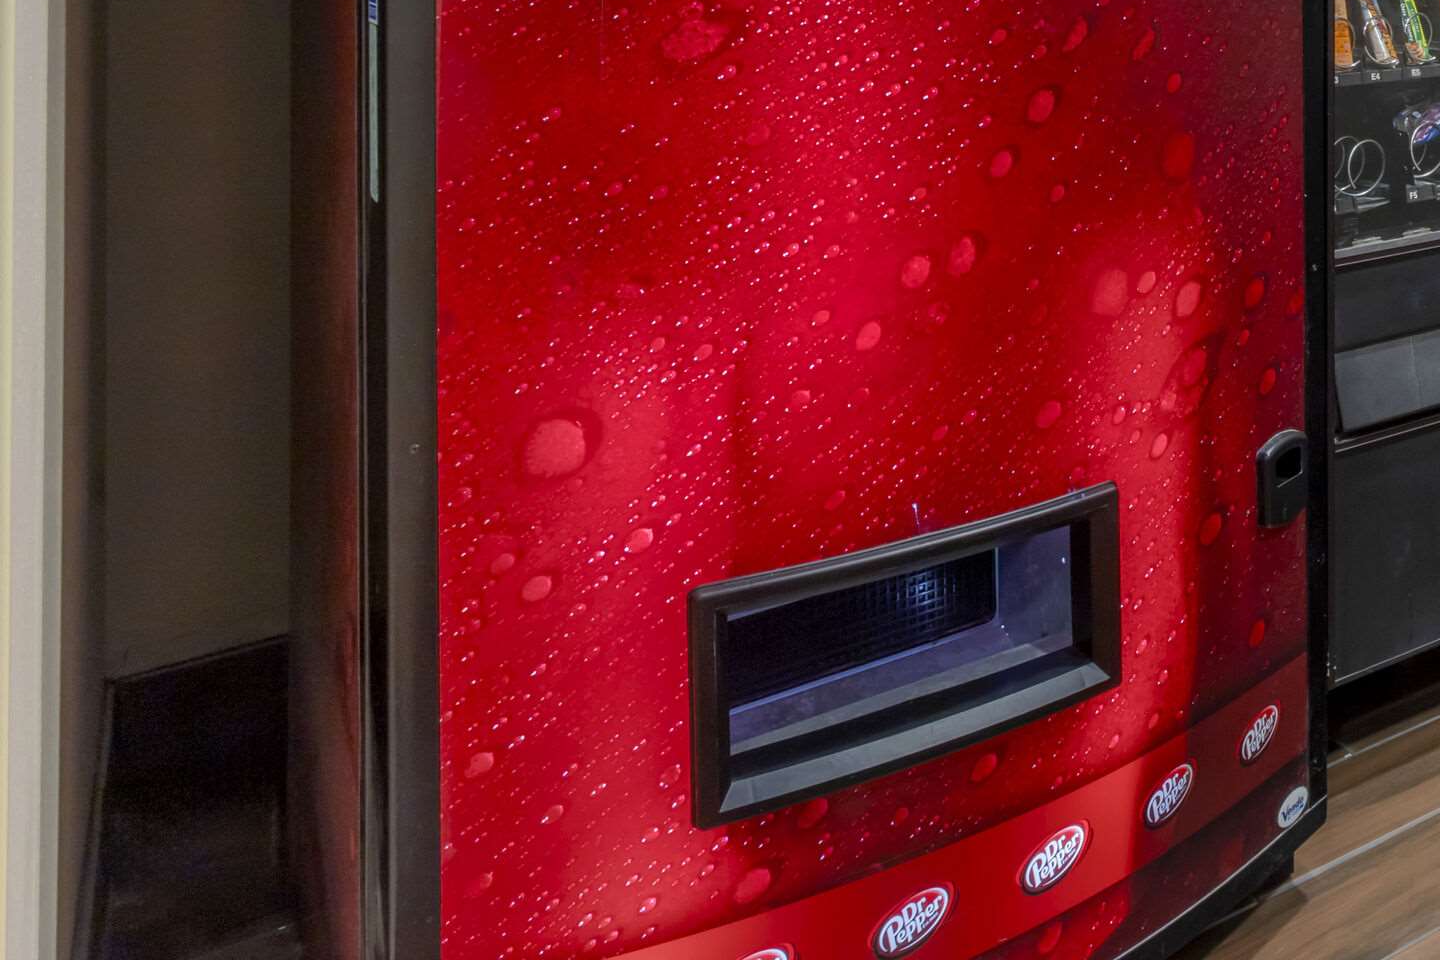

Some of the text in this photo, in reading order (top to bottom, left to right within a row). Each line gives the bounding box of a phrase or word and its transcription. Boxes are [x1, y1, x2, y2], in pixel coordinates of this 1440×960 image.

[1370, 73, 1381, 82] E4
[1409, 191, 1418, 200] F5
[1242, 711, 1275, 761] Pepper
[1254, 713, 1267, 734] Dr
[1147, 771, 1189, 824] Pepper
[1162, 773, 1179, 795] Dr
[1026, 832, 1079, 889] Pepper
[1045, 835, 1066, 860] Dr
[880, 895, 943, 952] Pepper
[901, 897, 927, 926] Dr
